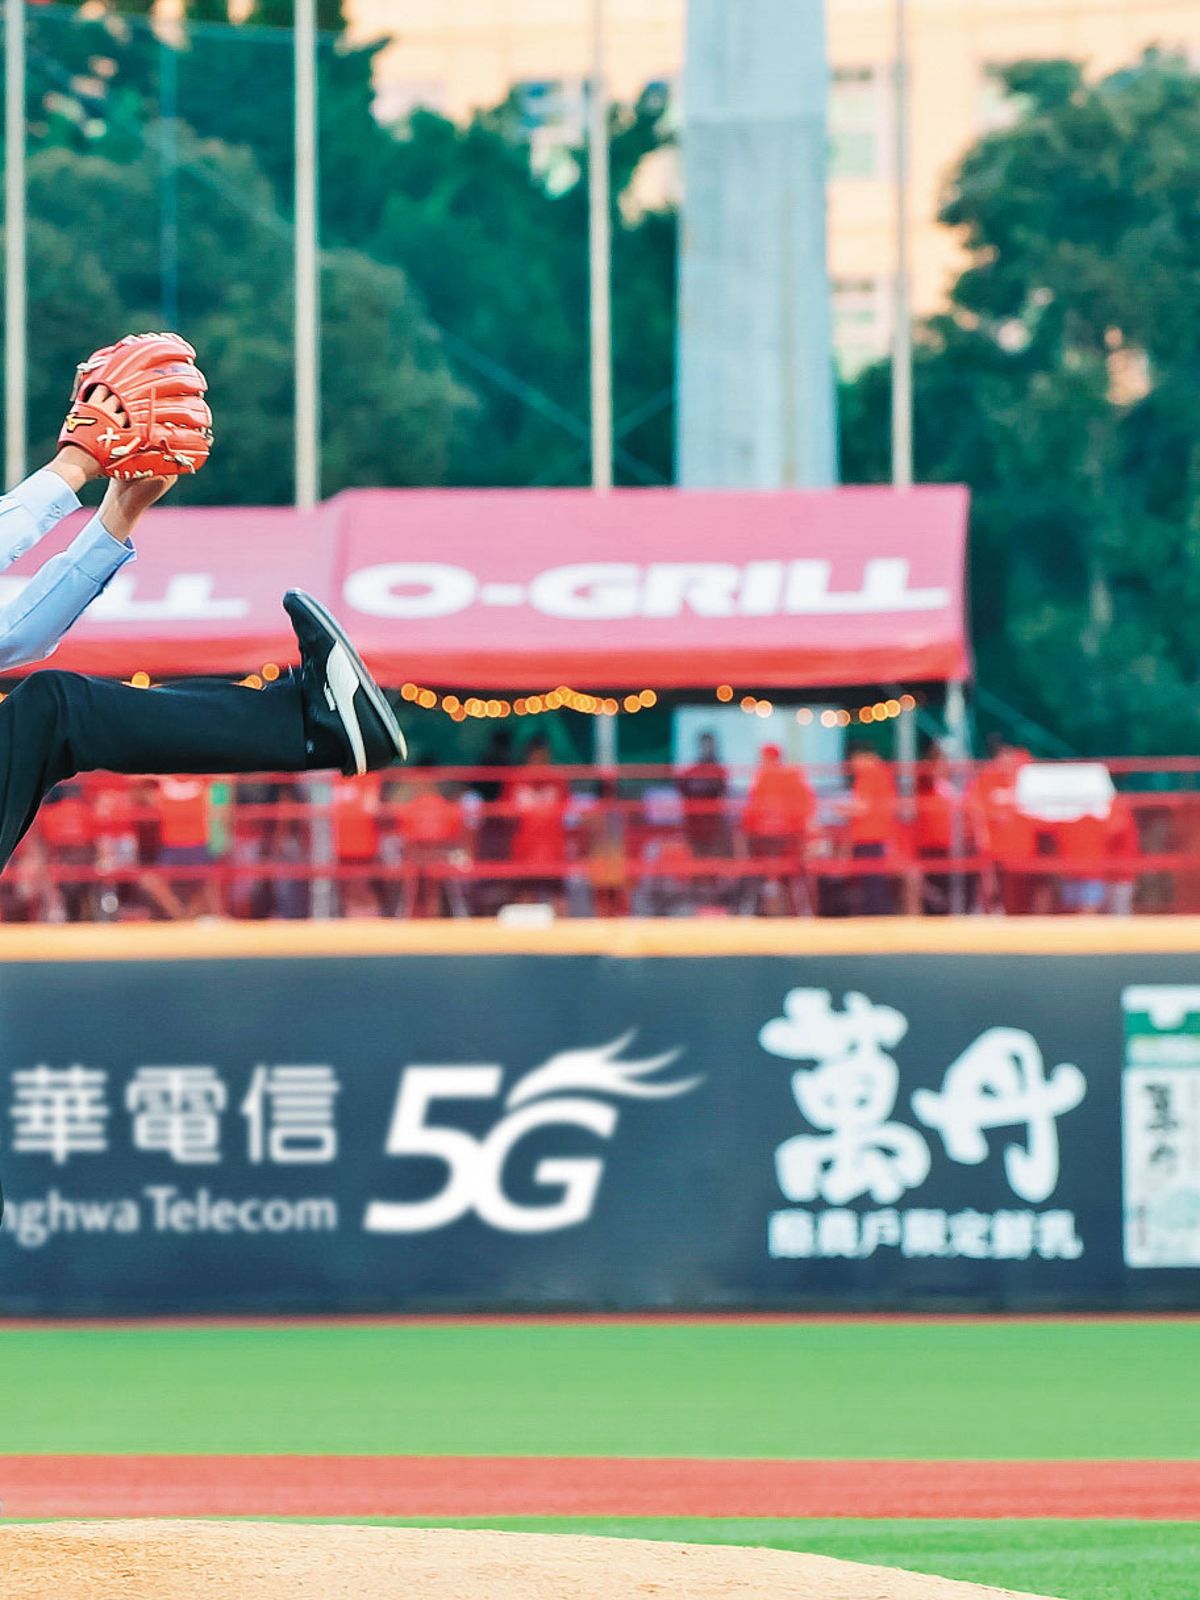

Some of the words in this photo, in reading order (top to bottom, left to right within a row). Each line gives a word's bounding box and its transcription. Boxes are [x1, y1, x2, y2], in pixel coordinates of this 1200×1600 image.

[343, 557, 951, 620] O-GRILL
[10, 1065, 340, 1164] 華電信
[760, 987, 1086, 1204] 萬丹
[363, 1064, 620, 1233] 5G
[145, 1185, 338, 1233] Telecom
